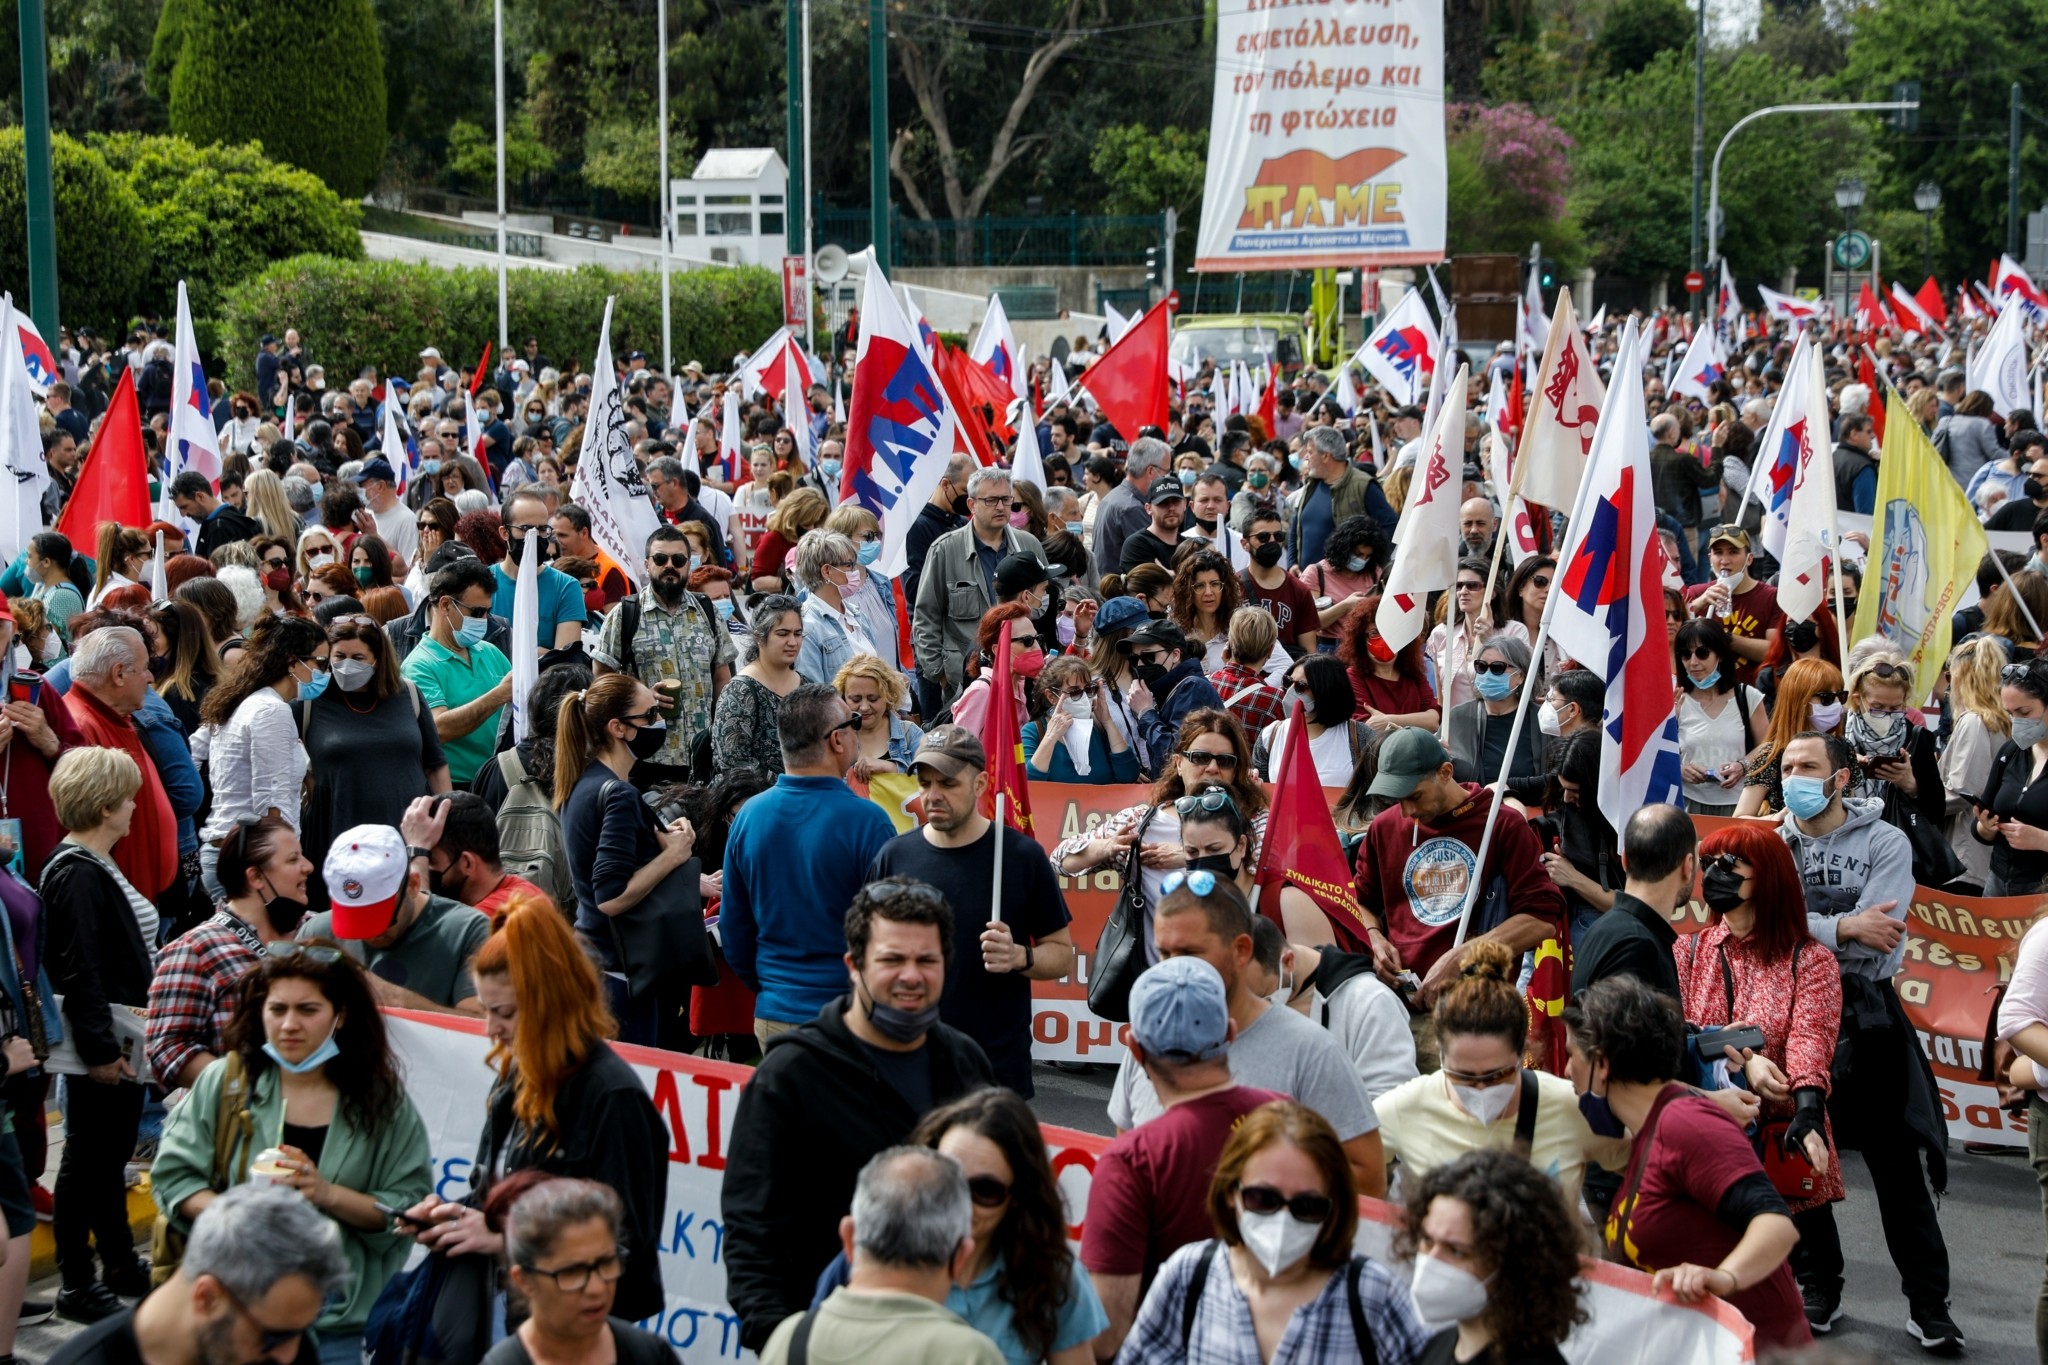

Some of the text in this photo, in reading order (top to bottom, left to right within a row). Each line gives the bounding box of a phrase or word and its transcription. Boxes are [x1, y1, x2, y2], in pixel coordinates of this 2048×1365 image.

[1235, 18, 1420, 59] εκμετάλλευση,
[1233, 59, 1421, 94] τον πόλεμο και
[1248, 99, 1397, 138] τη φτώχεια
[1286, 868, 1342, 895] ΣΥΝΔΙΚΑΤΟ
